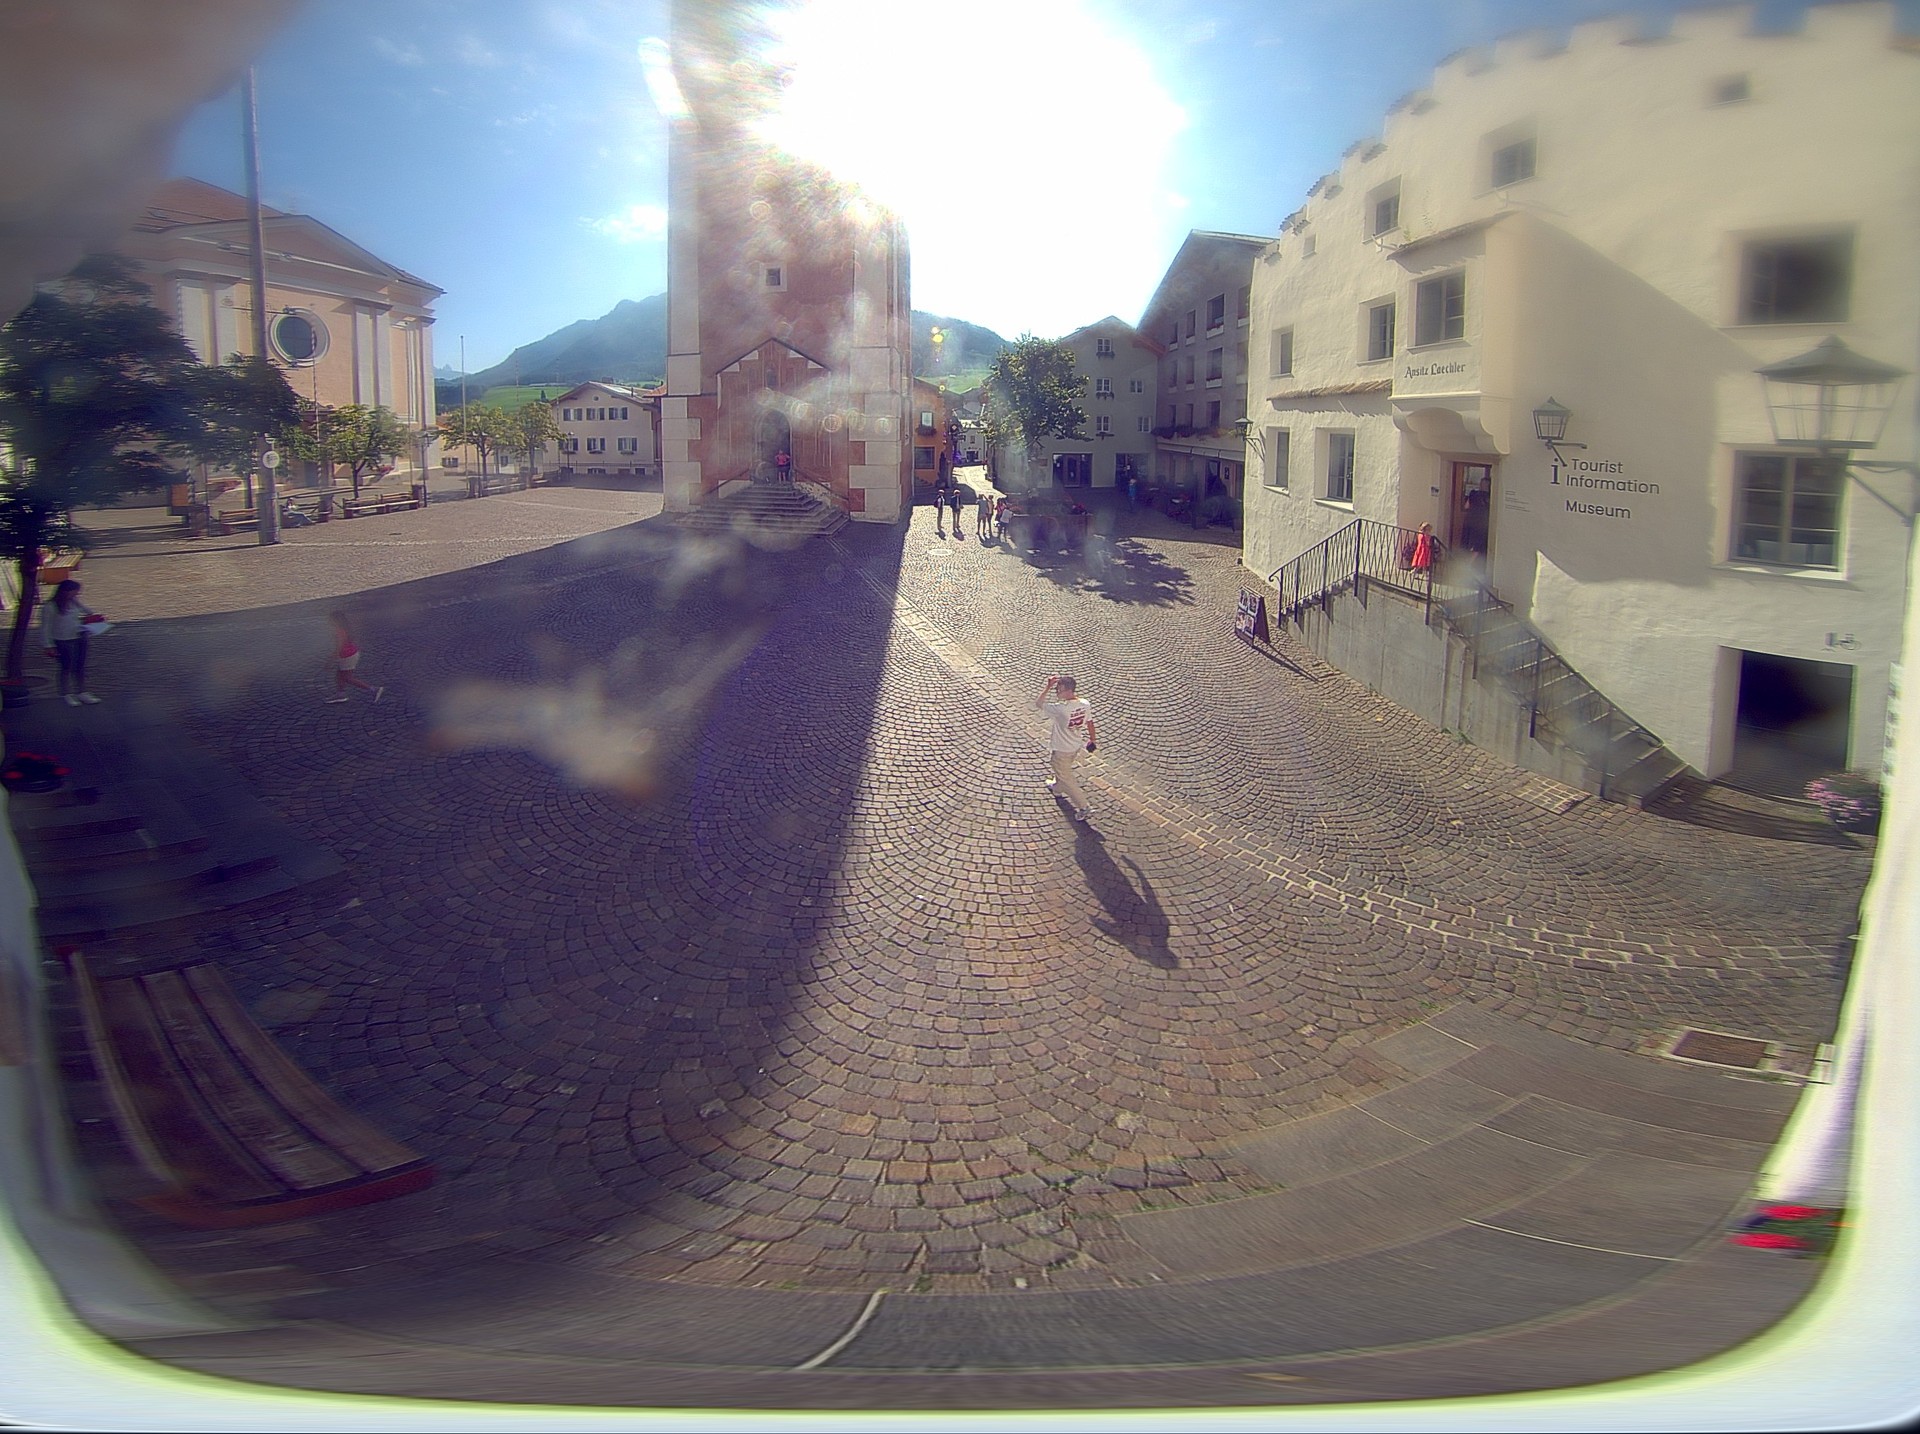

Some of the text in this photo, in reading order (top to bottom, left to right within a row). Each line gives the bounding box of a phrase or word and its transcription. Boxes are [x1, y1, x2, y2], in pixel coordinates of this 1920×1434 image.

[1571, 458, 1623, 474] Tourist
[1566, 474, 1660, 495] Information
[1566, 499, 1631, 519] Museum
